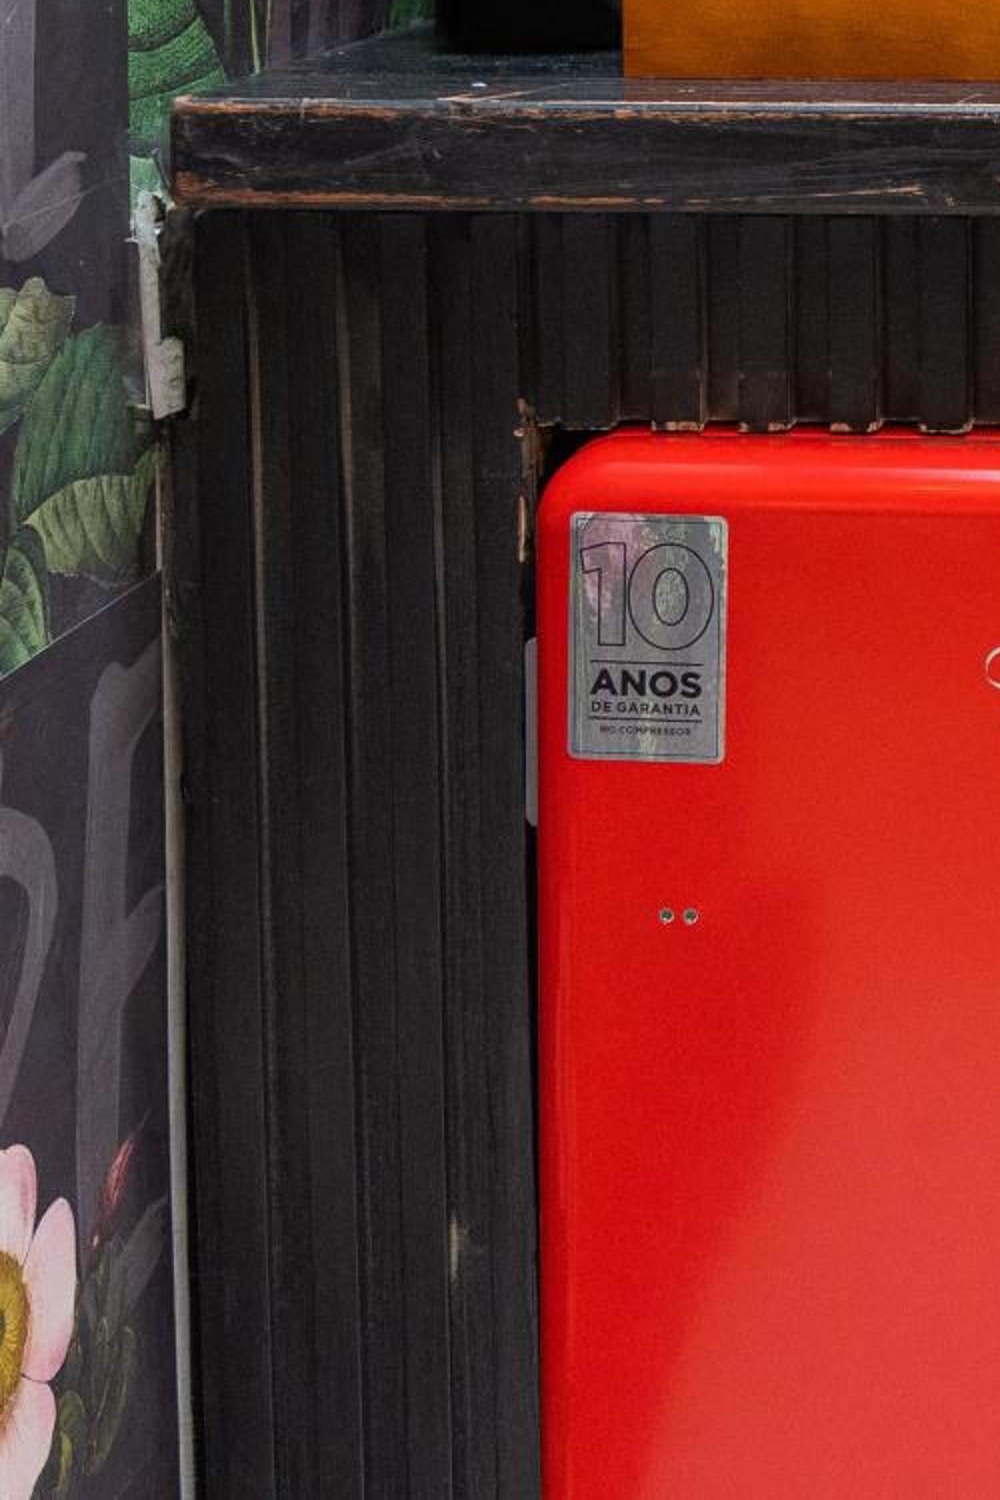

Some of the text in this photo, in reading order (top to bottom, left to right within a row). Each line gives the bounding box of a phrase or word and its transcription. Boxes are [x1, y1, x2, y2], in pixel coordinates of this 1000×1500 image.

[580, 541, 714, 650] 10
[590, 669, 702, 698] ANOS
[591, 701, 700, 716] DE GARANTIA
